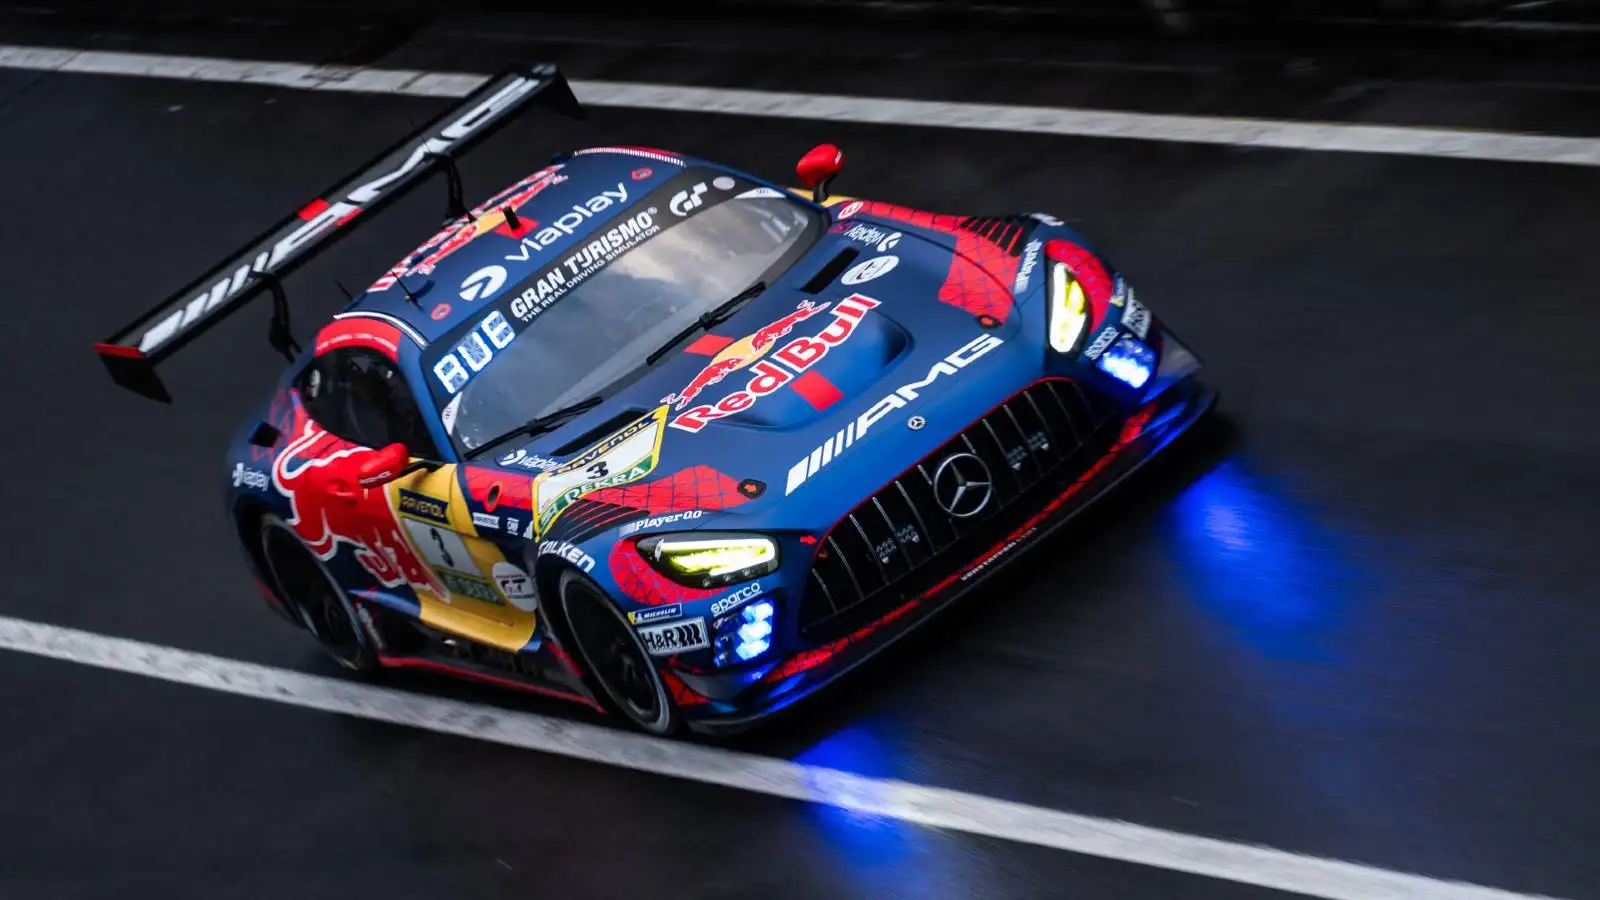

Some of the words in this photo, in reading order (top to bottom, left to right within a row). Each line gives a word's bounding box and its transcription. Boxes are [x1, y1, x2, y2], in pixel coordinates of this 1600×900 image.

[504, 182, 628, 264] viaplay
[521, 306, 543, 323] THE
[541, 287, 568, 308] REAL
[566, 259, 606, 289] DRIVING
[605, 224, 661, 261] SIMULATOR
[510, 268, 566, 320] GRAN
[667, 360, 795, 434] Red
[772, 292, 883, 374] Bull
[563, 466, 646, 503] DEKRA
[586, 460, 610, 481] 3
[642, 607, 678, 620] MICHELIN
[710, 581, 761, 615] sparco
[641, 628, 679, 651] H&R
